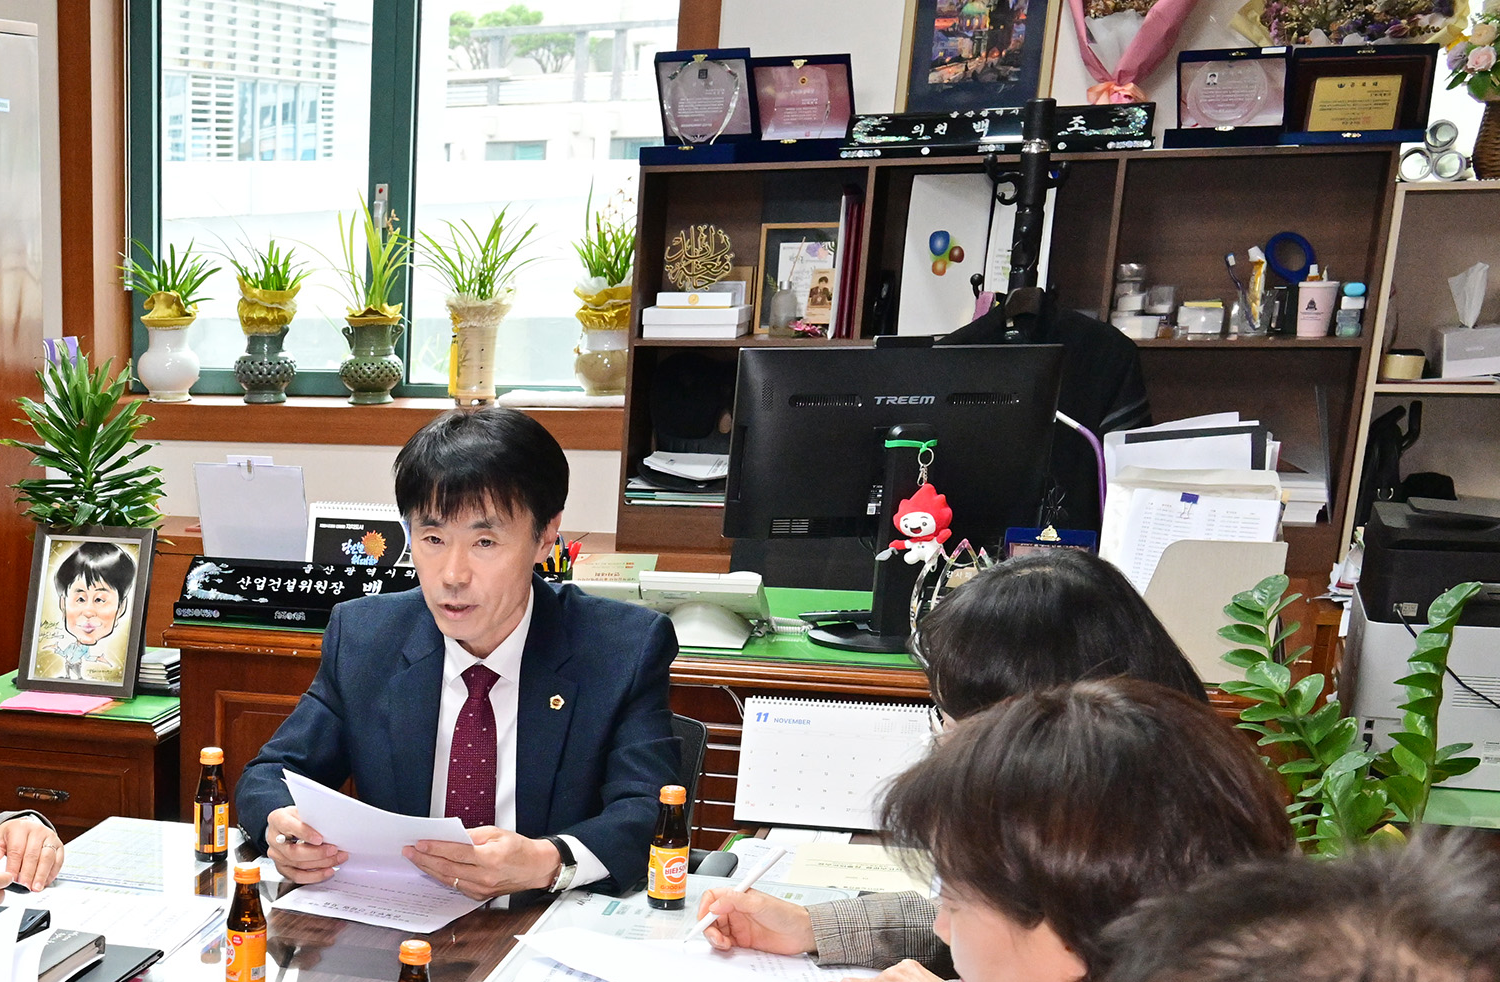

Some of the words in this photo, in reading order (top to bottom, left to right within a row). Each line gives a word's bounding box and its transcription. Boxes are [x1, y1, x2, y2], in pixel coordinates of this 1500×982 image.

[911, 122, 948, 137] 의원
[874, 395, 936, 406] TREEM
[302, 564, 417, 579] 울산광역시의
[237, 576, 346, 596] 산업건설위원장
[755, 712, 769, 723] 11
[773, 717, 811, 726] NOVEMBER
